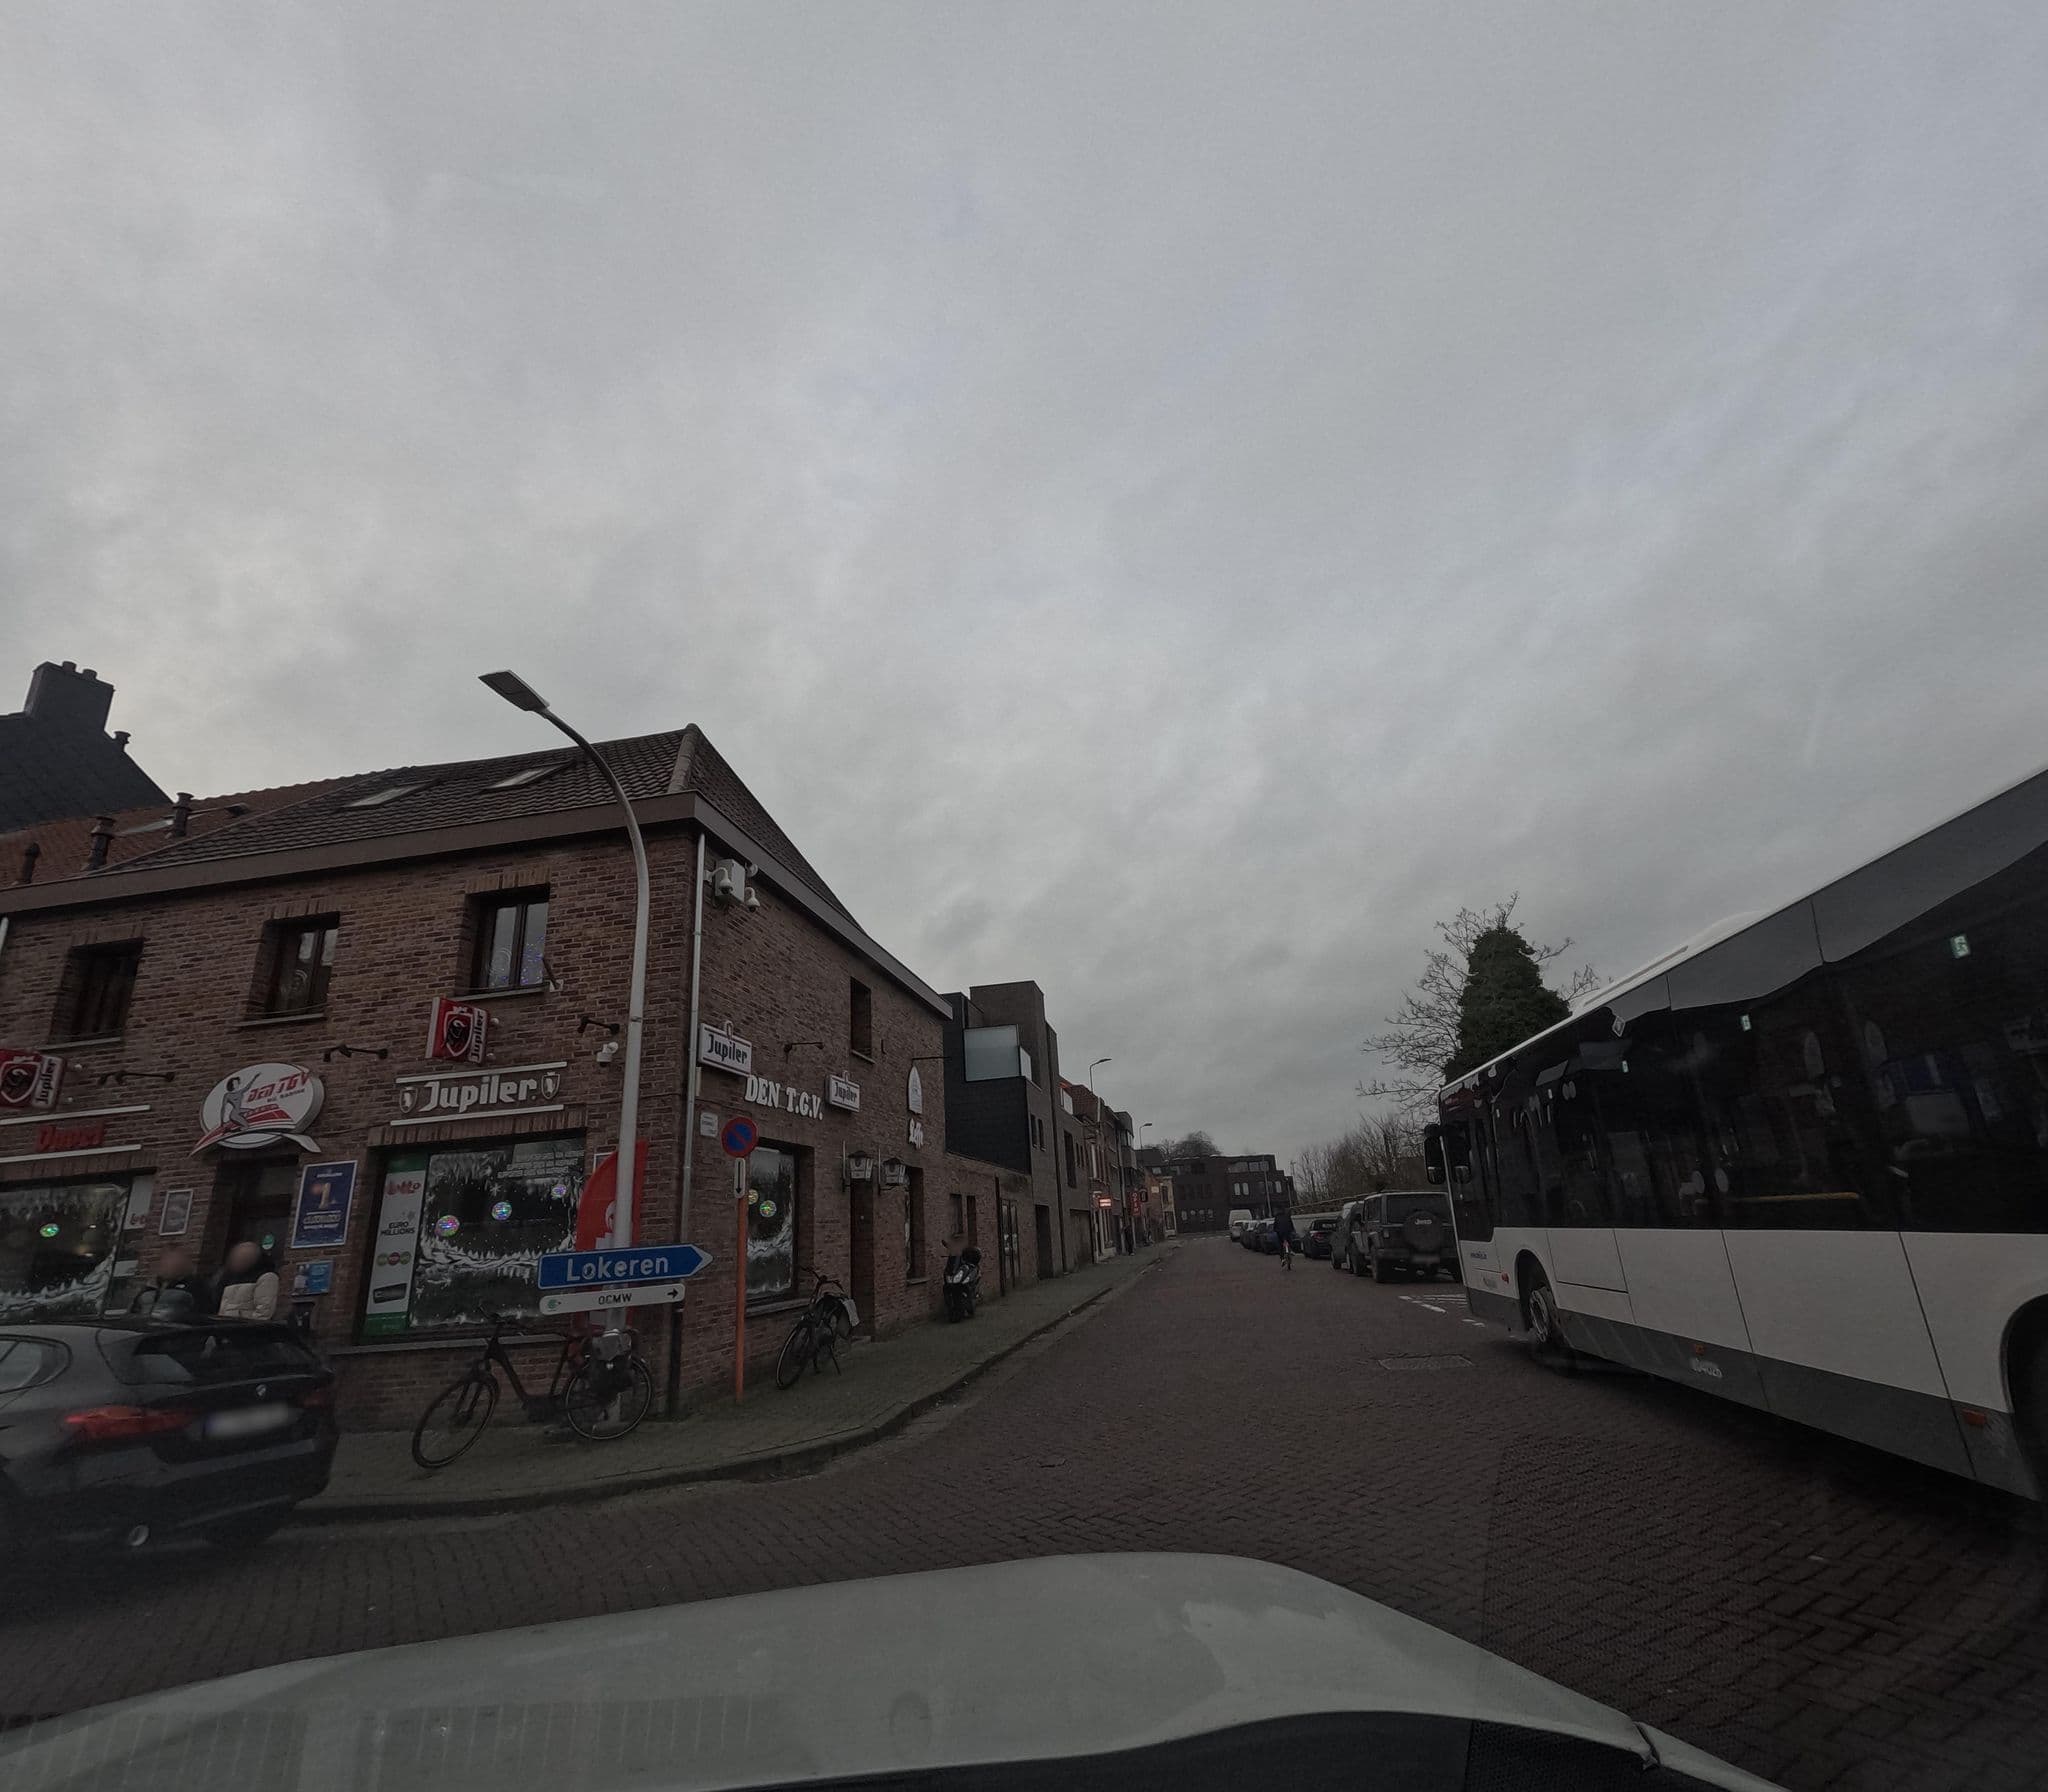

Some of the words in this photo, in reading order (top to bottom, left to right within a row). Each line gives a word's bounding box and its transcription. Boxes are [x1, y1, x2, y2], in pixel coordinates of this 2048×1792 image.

[471, 1010, 485, 1060] Jupiler
[708, 1033, 748, 1064] Jupiler
[36, 1058, 58, 1105] Jupiler
[834, 1081, 858, 1104] Jupiler
[745, 1074, 780, 1109] DEN
[786, 1086, 824, 1121] T.G.V.
[566, 1255, 669, 1282] Lokeren
[598, 1292, 632, 1305] OCMW
